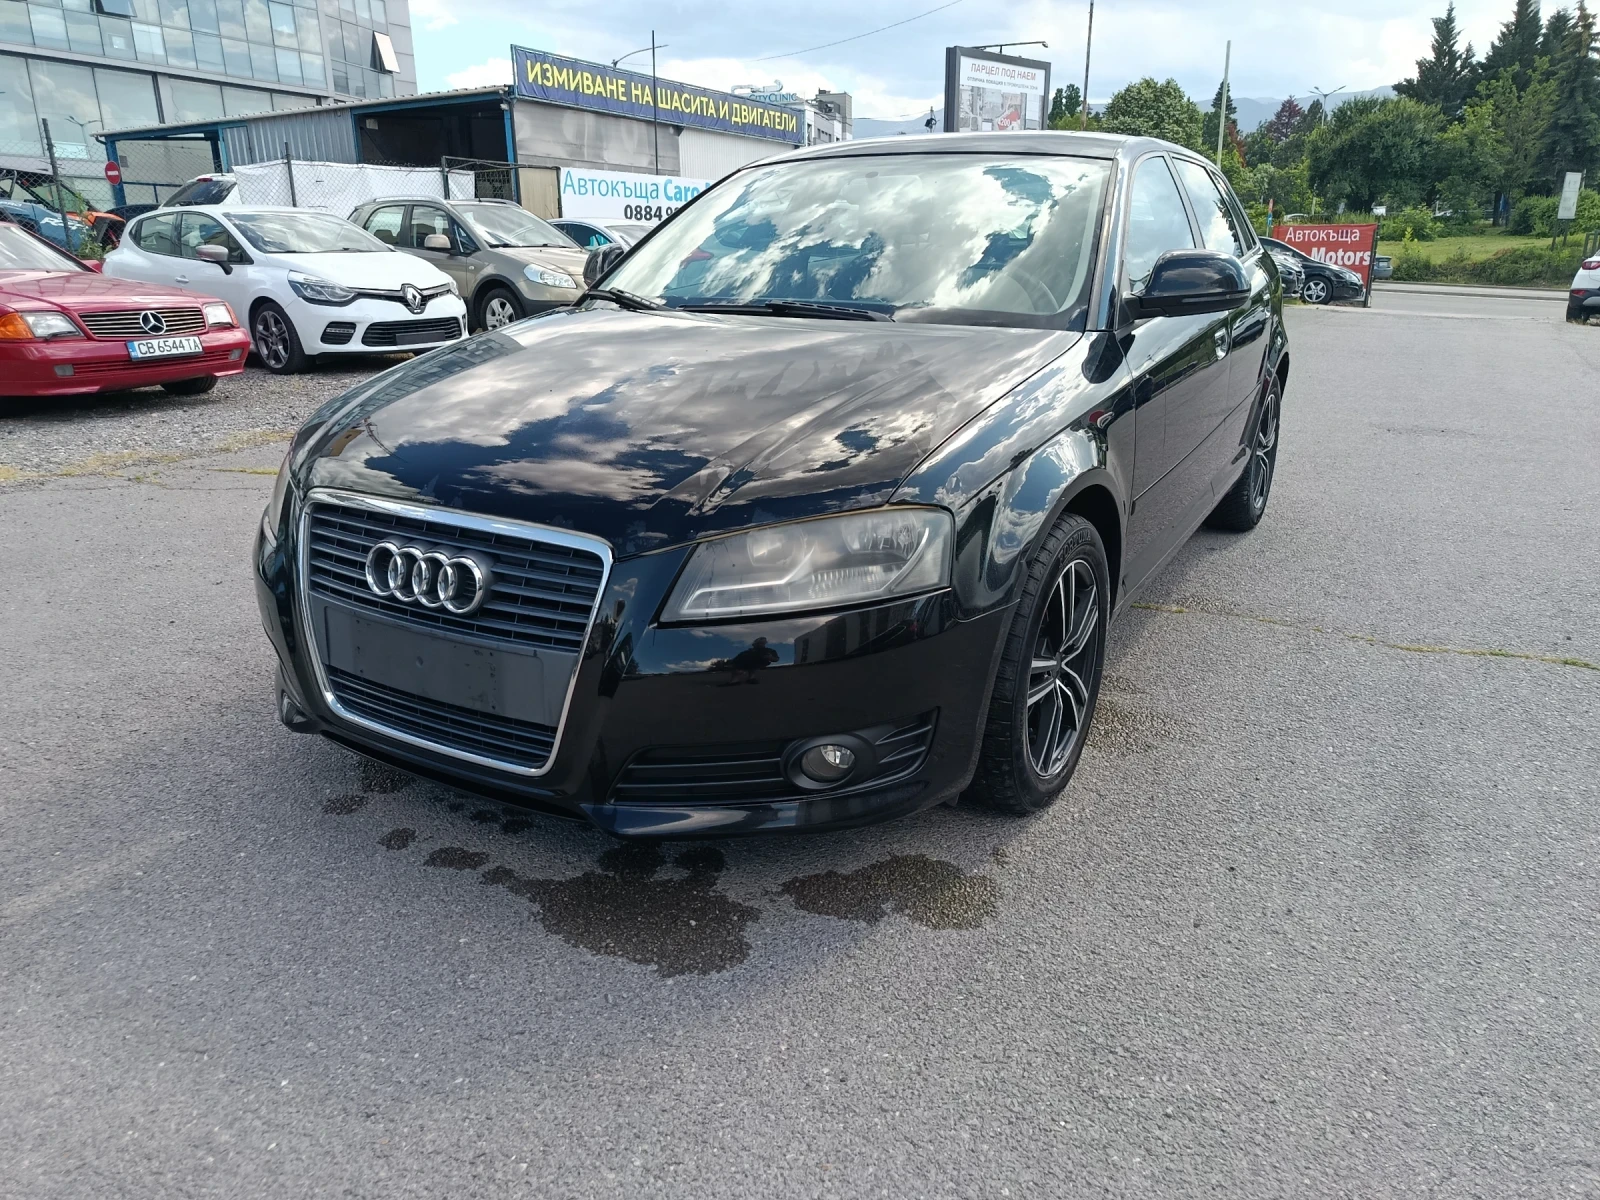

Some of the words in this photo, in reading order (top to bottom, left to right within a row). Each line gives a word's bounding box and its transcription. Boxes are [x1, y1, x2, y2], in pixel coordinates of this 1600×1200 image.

[971, 63, 1000, 76] ПАРЦЕЛ
[1001, 67, 1016, 80] ПОД
[1017, 70, 1036, 81] НАЕМ
[526, 59, 627, 101] ИЗМИВАНЕ
[631, 82, 654, 107] НА
[657, 87, 716, 118] ШАСИТА
[719, 101, 729, 120] И
[732, 103, 797, 133] ДВИГАТЕЛИ
[664, 178, 700, 202] Caro
[624, 204, 663, 221] 0884
[1310, 247, 1371, 265] Motors
[138, 341, 156, 355] CB
[157, 340, 185, 353] 6544
[185, 338, 200, 351] TA
